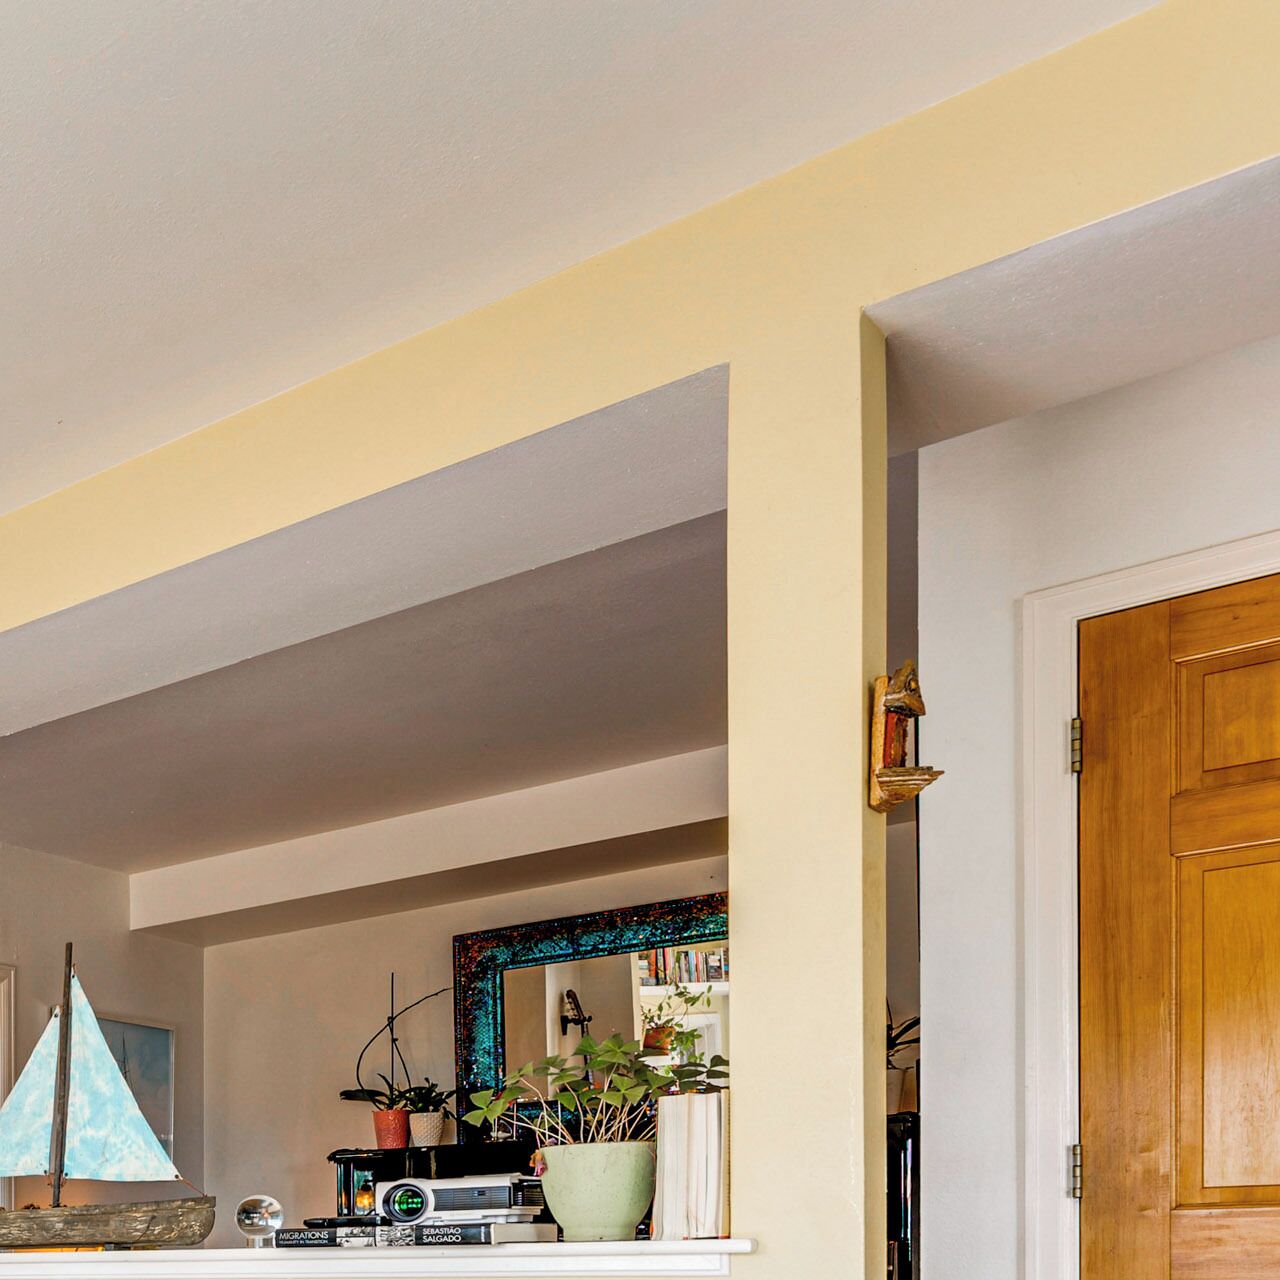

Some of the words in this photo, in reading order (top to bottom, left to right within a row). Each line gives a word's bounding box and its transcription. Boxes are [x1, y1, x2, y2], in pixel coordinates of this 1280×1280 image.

[278, 1230, 329, 1240] MIGRATIONS
[422, 1226, 462, 1235] SEBASTIÃO
[422, 1234, 462, 1244] SALGADO
